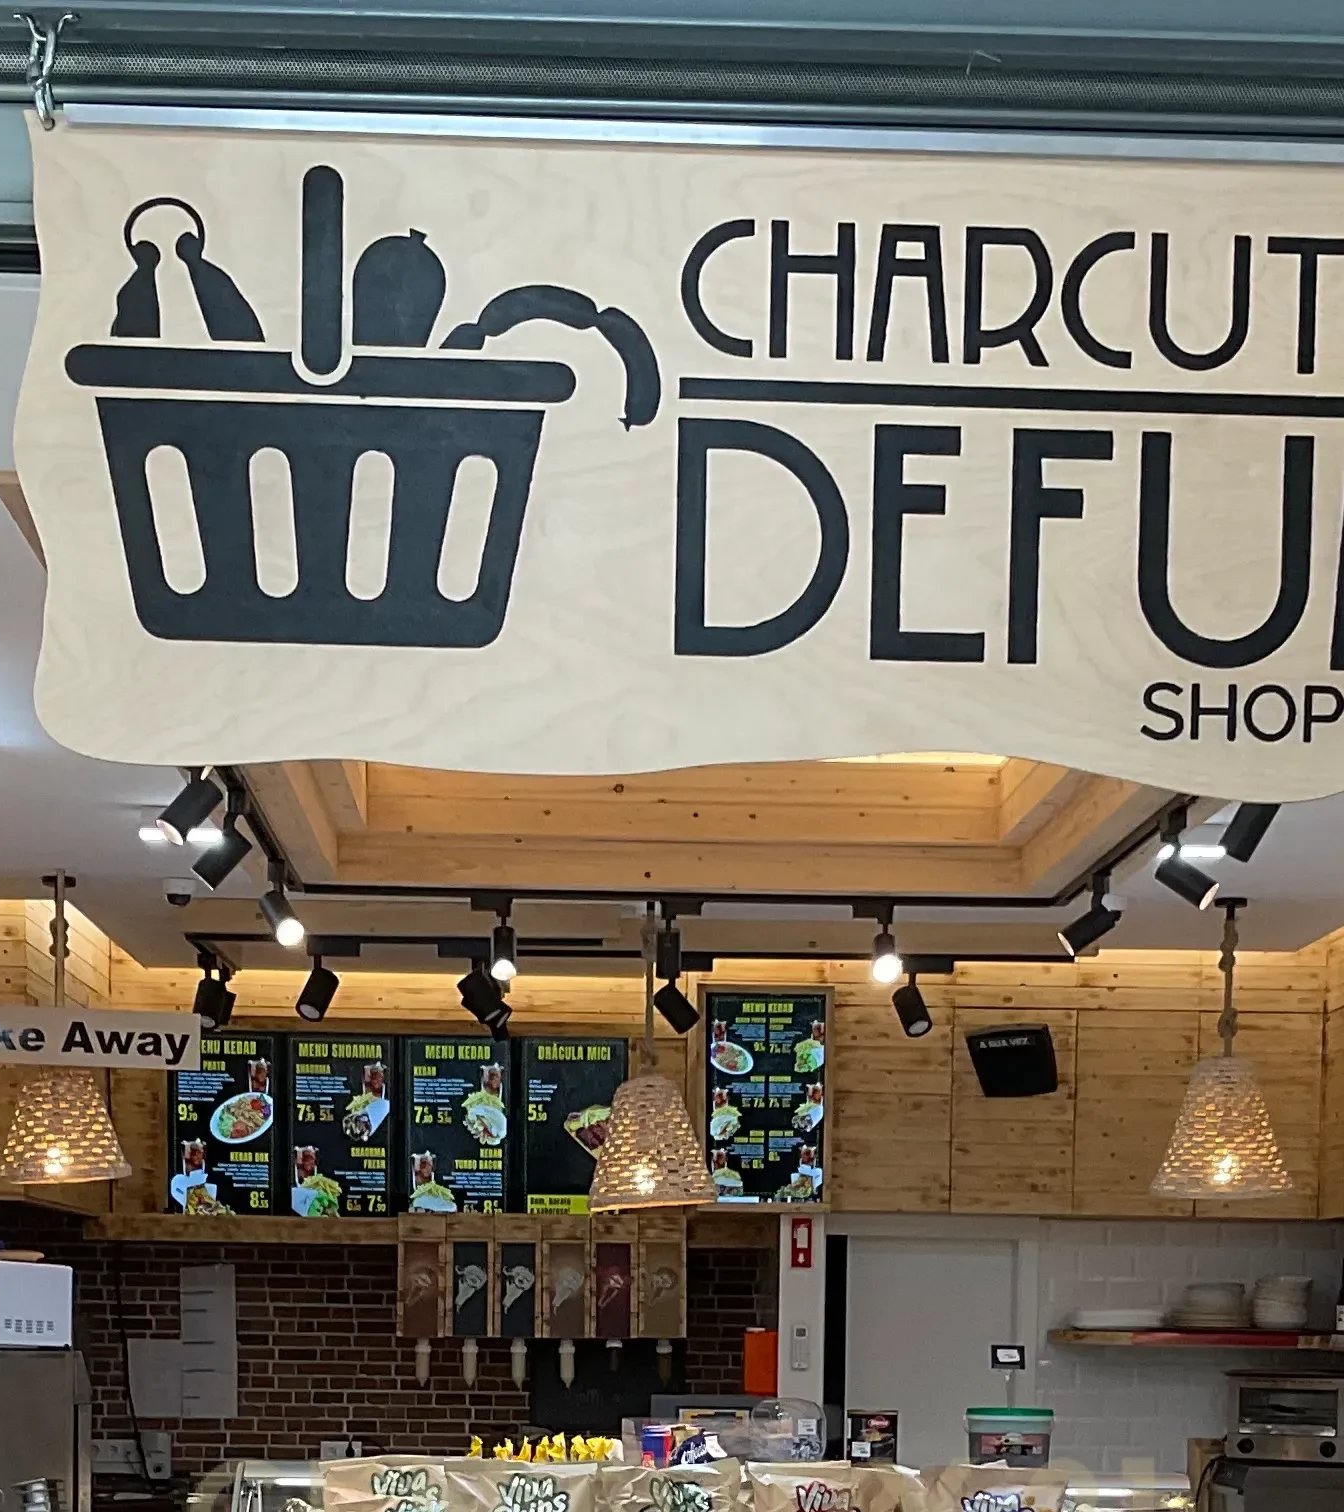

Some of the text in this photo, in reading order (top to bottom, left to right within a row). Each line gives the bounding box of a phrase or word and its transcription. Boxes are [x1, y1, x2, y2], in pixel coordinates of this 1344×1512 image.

[1142, 681, 1344, 743] SHOP
[61, 1021, 190, 1066] Away
[201, 1040, 221, 1055] ENU
[299, 1043, 328, 1058] MENU
[425, 1045, 455, 1060] MENU
[497, 1472, 556, 1506] Viva
[796, 1481, 853, 1512] Viva
